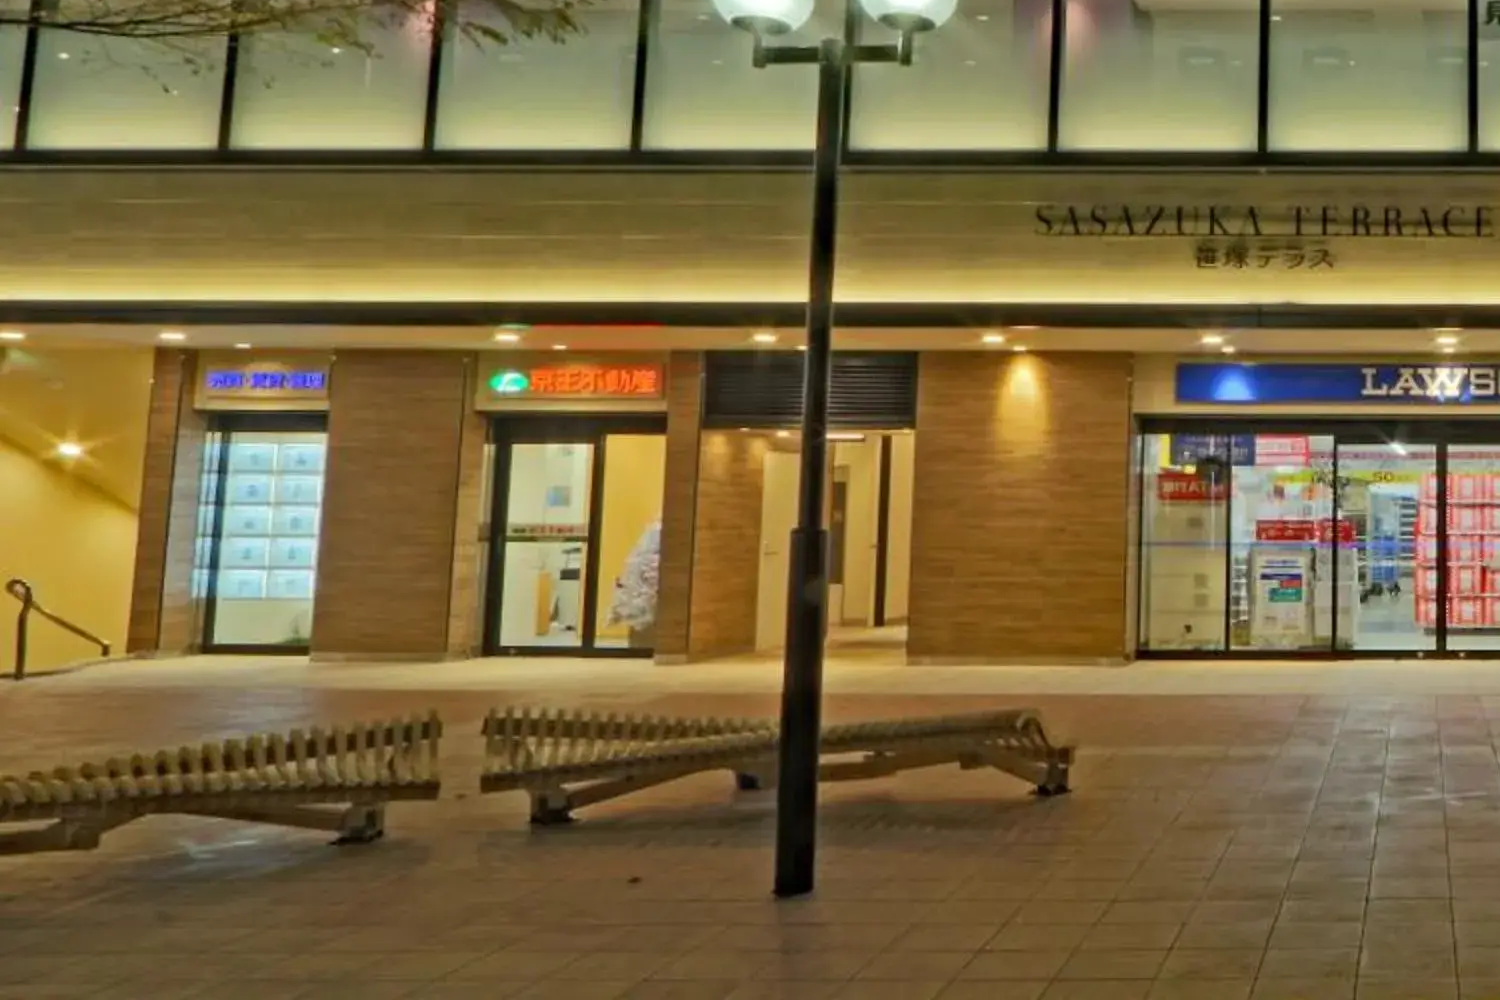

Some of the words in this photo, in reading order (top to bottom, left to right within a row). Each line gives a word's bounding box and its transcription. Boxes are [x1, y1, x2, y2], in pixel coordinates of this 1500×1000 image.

[1034, 205, 1263, 236] SASAZUKA
[1290, 205, 1496, 238] TERRACE
[1195, 245, 1335, 269] 笹塚テラス
